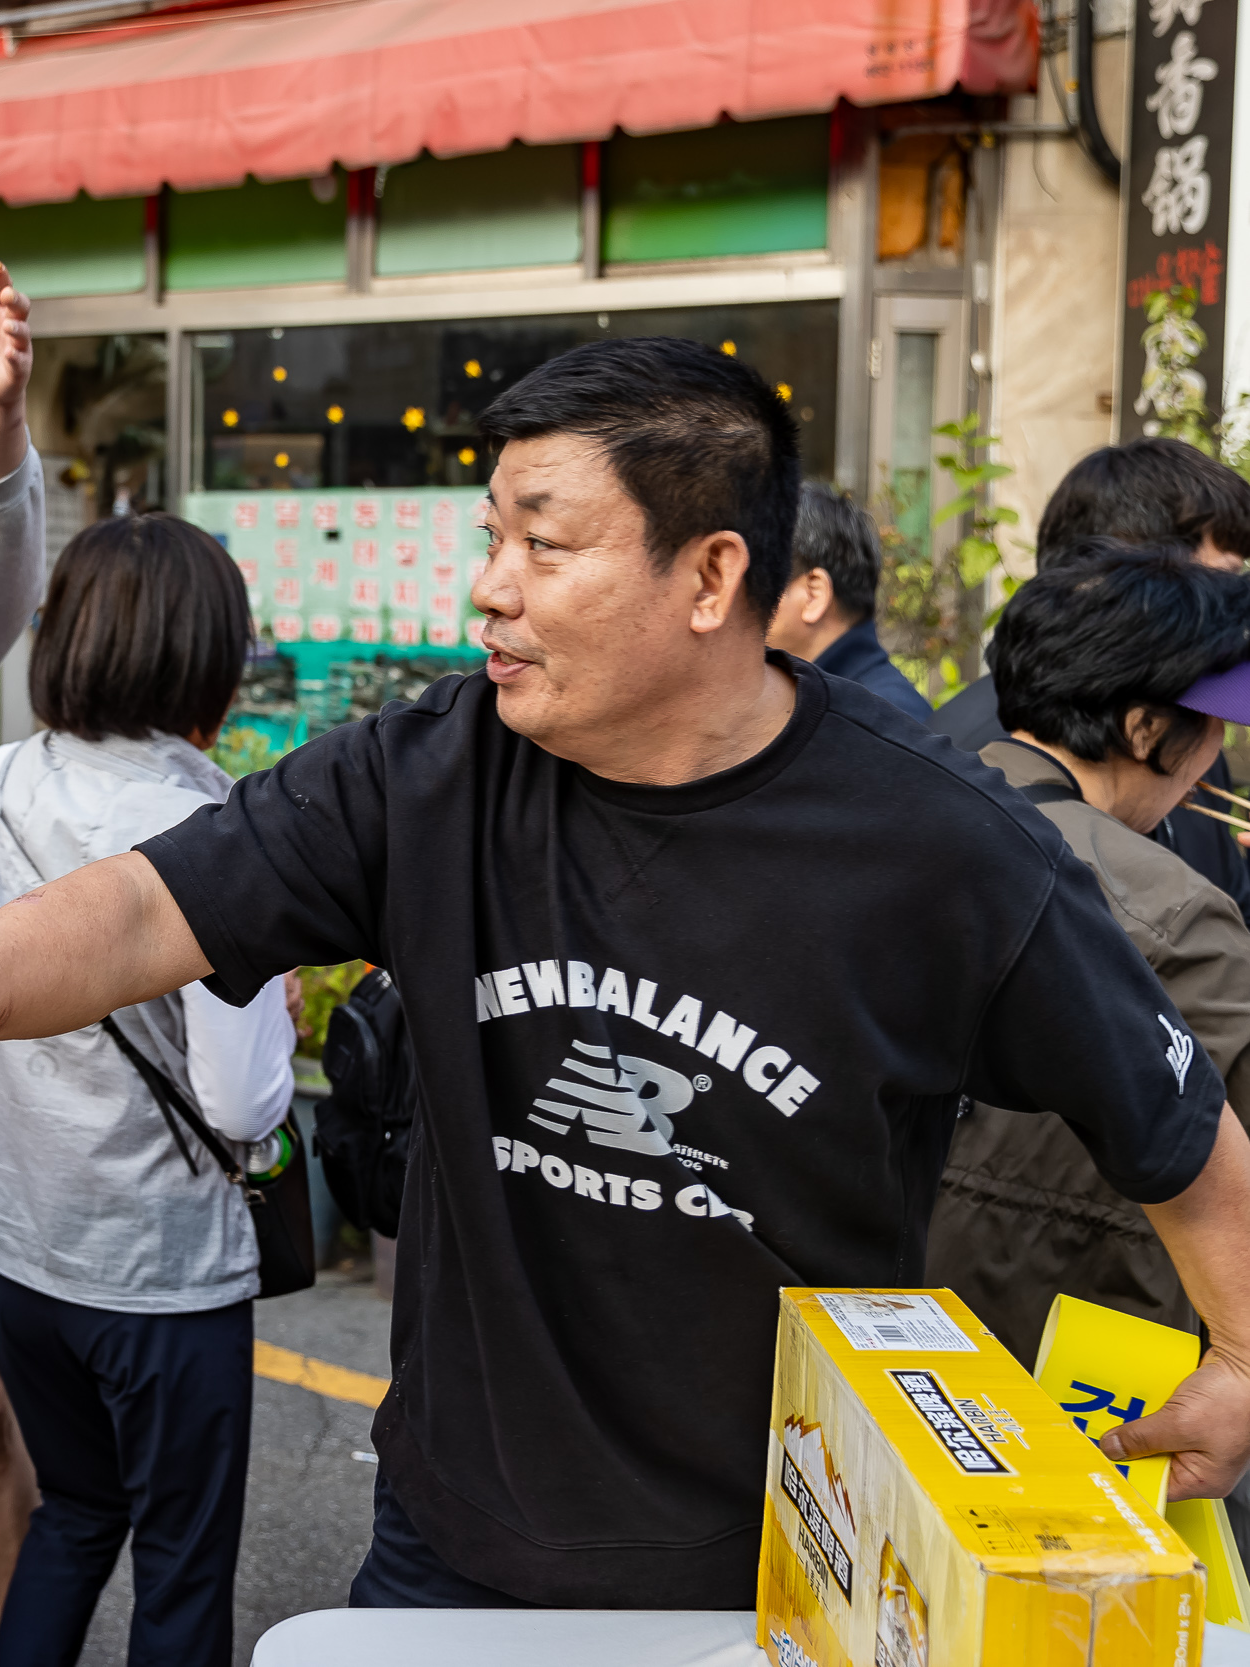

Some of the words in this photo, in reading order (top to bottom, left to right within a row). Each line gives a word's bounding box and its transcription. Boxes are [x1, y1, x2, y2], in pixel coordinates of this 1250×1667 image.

[492, 1136, 663, 1211] SPORTS
[954, 1399, 1007, 1444] HARBIN
[784, 1456, 848, 1591] 哈尔滨啤酒
[799, 1521, 829, 1591] HARBIN
[1178, 1593, 1192, 1616] 24
